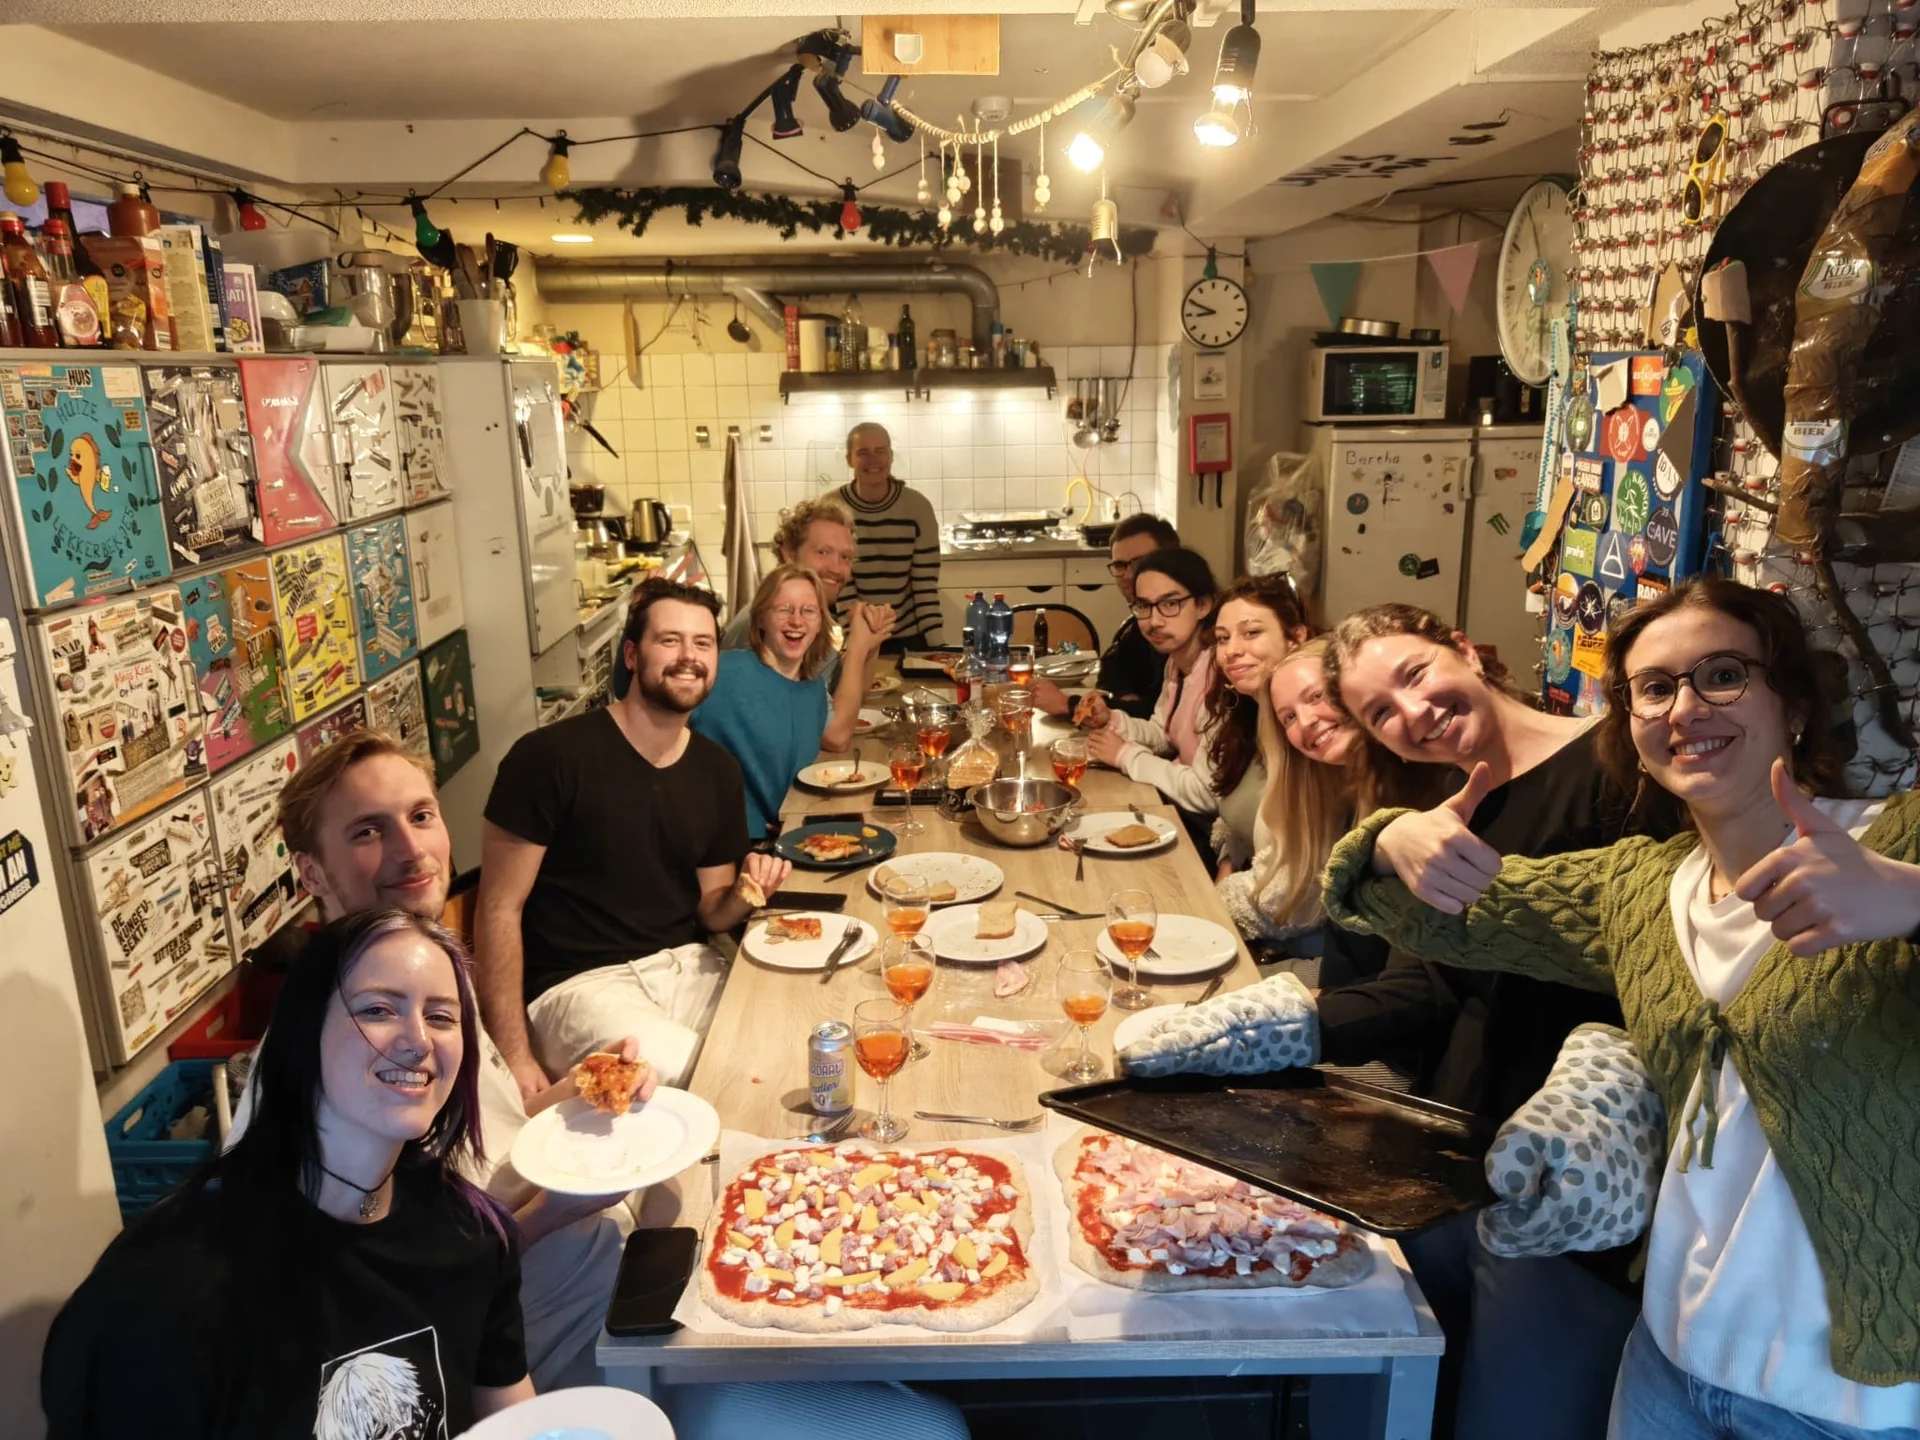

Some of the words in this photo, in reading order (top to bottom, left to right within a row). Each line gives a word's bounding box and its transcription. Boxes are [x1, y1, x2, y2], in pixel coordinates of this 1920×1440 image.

[67, 368, 92, 387] HUIS
[56, 398, 99, 425] HUIZE
[1793, 427, 1825, 436] BIER
[1647, 521, 1677, 549] CAVE
[111, 912, 125, 933] DE
[121, 919, 149, 957] SEKTE
